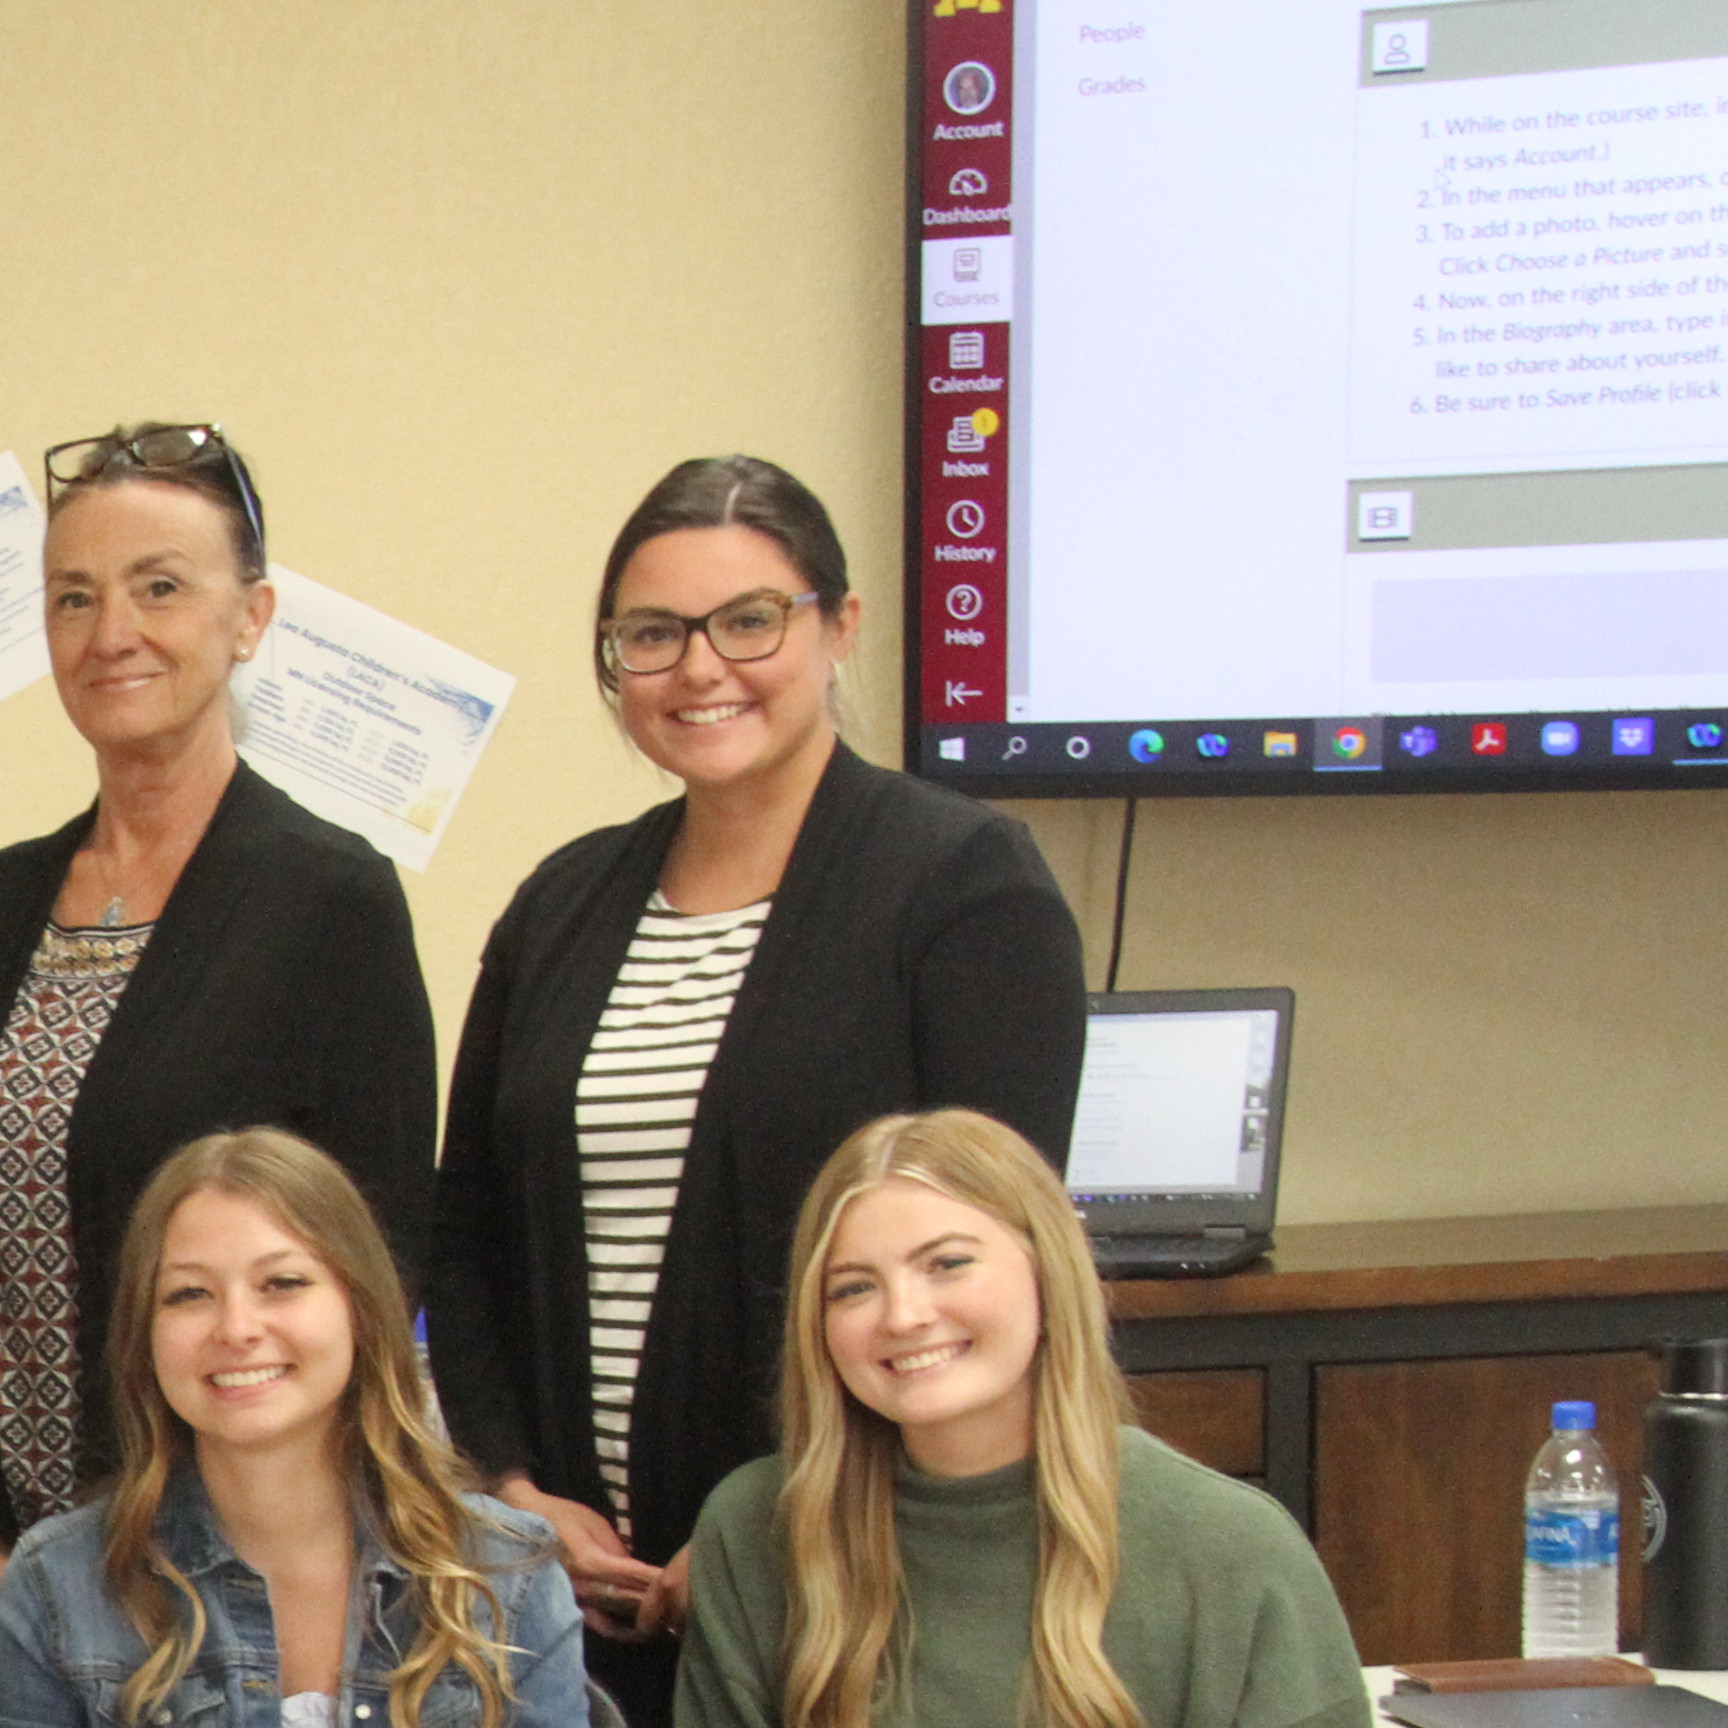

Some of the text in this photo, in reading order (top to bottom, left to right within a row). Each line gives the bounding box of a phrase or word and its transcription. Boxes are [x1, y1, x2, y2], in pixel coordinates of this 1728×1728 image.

[1079, 23, 1146, 44] People
[1078, 76, 1146, 96] Grades
[933, 121, 1005, 140] Account
[1445, 116, 1506, 136] While
[1512, 116, 1539, 132] on
[1546, 111, 1580, 129] the
[1587, 105, 1658, 126] course
[1463, 154, 1507, 172] says
[1442, 189, 1461, 206] In
[1468, 186, 1501, 204] the
[1508, 184, 1566, 201] menu
[1574, 179, 1616, 197] that
[923, 203, 1012, 226] Dashboard
[1441, 222, 1464, 241] To
[1470, 220, 1509, 239] add
[1516, 223, 1527, 236] a
[1608, 212, 1669, 229] hover
[1676, 209, 1702, 224] on
[1439, 257, 1488, 276] Click
[1496, 252, 1568, 272] Choose
[1574, 253, 1587, 266] a
[1593, 246, 1663, 266] Picture
[1670, 241, 1711, 260] and
[934, 291, 999, 307] Courses
[1498, 291, 1524, 306] on
[1531, 287, 1565, 304] the
[1572, 283, 1620, 306] right
[1627, 280, 1669, 298] side
[1677, 276, 1699, 295] of
[1437, 327, 1456, 344] In
[1463, 325, 1496, 343] the
[1503, 320, 1602, 343] Biography
[1666, 314, 1714, 333] type
[1436, 360, 1470, 379] like
[1477, 360, 1498, 377] to
[1505, 355, 1560, 375] share
[1567, 353, 1627, 372] about
[929, 375, 1004, 394] Calendar
[1435, 395, 1462, 413] Be
[1468, 394, 1511, 411] sure
[1518, 391, 1539, 408] to
[1545, 389, 1592, 407] Save
[1599, 383, 1662, 405] Profile
[942, 461, 990, 477] Inbox
[934, 545, 997, 563] History
[945, 629, 985, 647] Help
